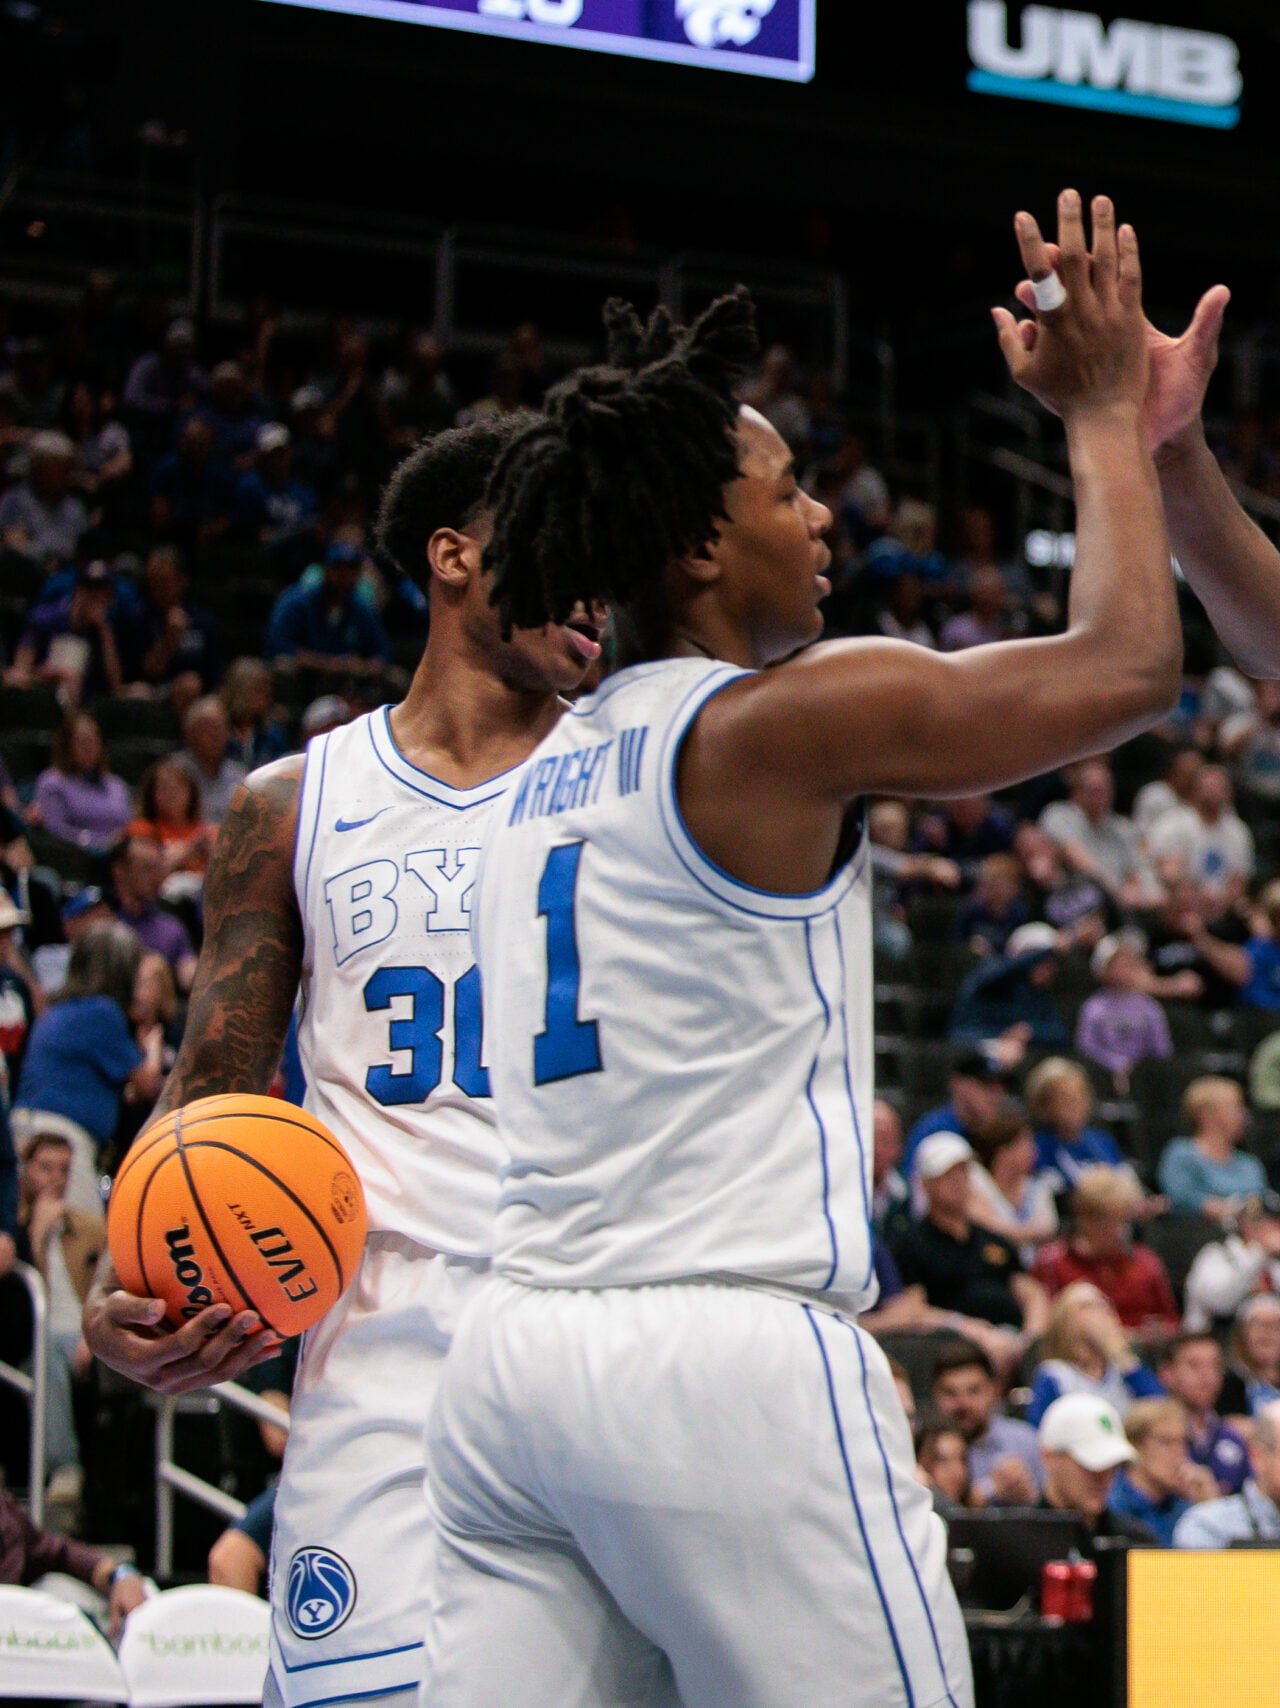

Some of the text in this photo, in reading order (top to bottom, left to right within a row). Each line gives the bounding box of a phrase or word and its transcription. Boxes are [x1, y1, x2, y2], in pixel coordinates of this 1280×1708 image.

[966, 0, 1243, 108] UMB
[324, 847, 483, 968] BY
[534, 839, 604, 1087] 1
[226, 1202, 256, 1231] NXT
[303, 1601, 326, 1623] Y
